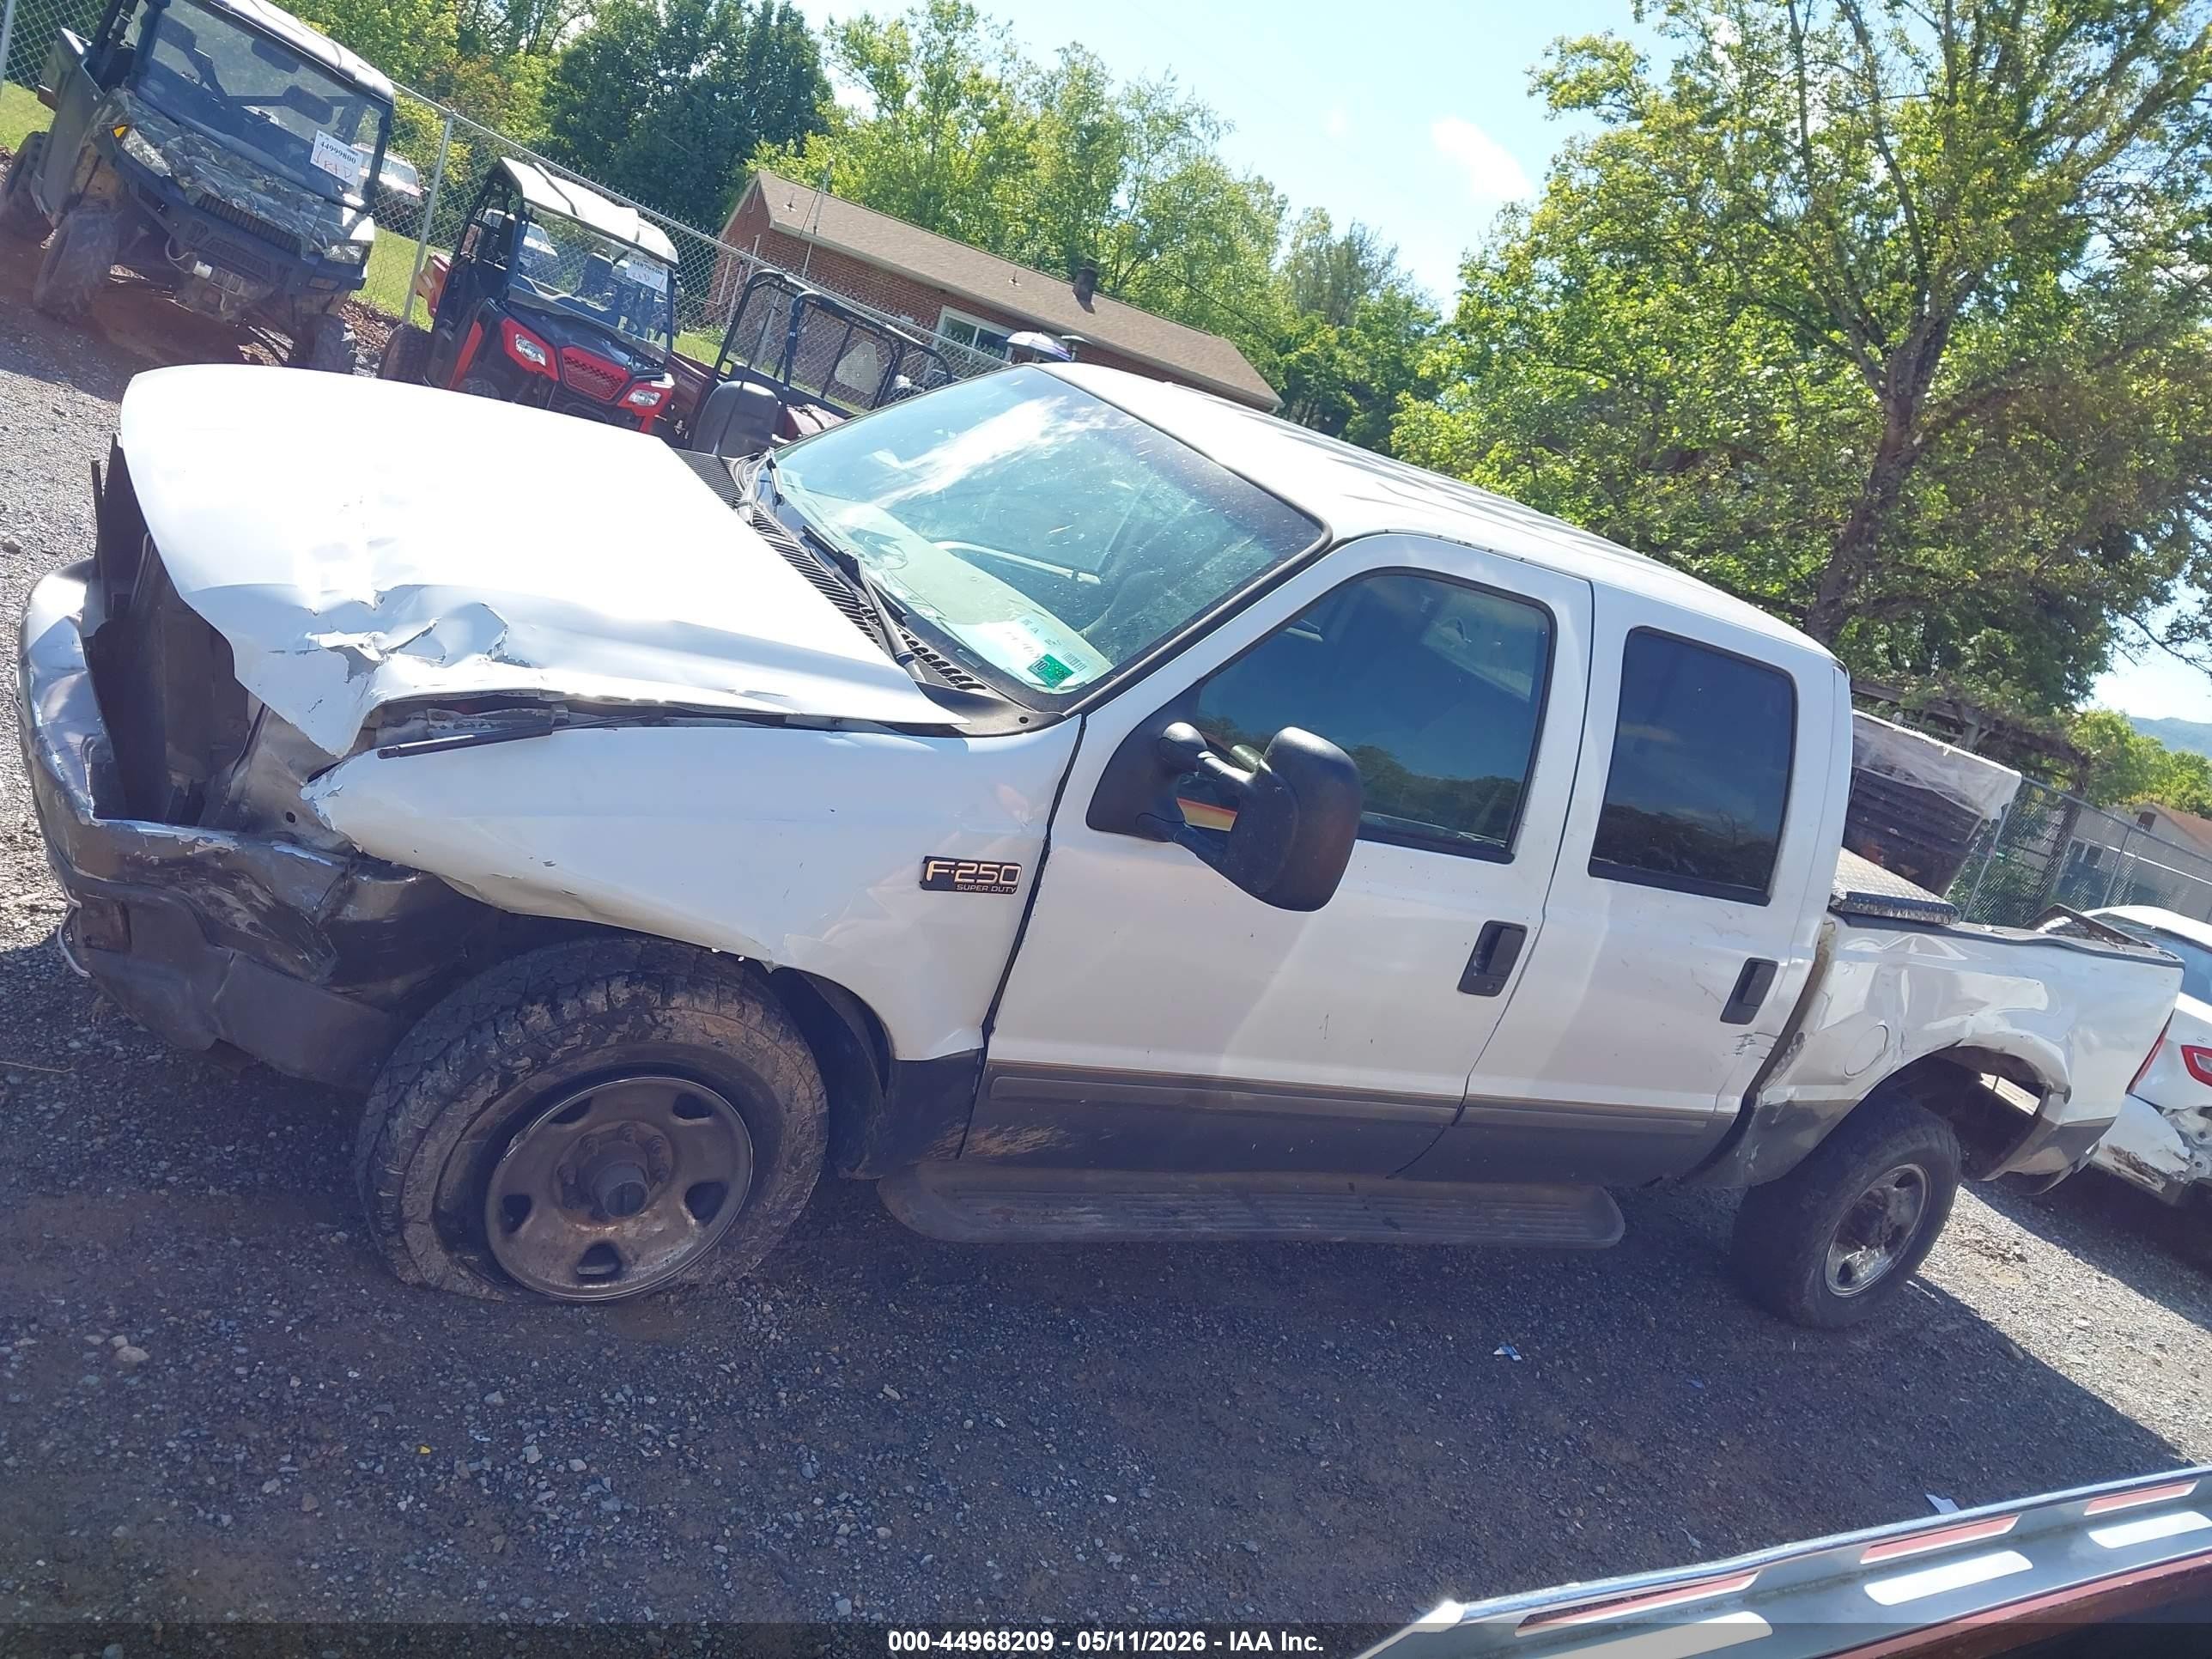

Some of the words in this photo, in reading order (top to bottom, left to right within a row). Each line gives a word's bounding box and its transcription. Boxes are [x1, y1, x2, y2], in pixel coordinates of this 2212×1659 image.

[320, 140, 357, 165] 44999800
[1033, 659, 1048, 672] 10
[956, 884, 988, 892] SUPER
[991, 884, 1017, 894] DUTY
